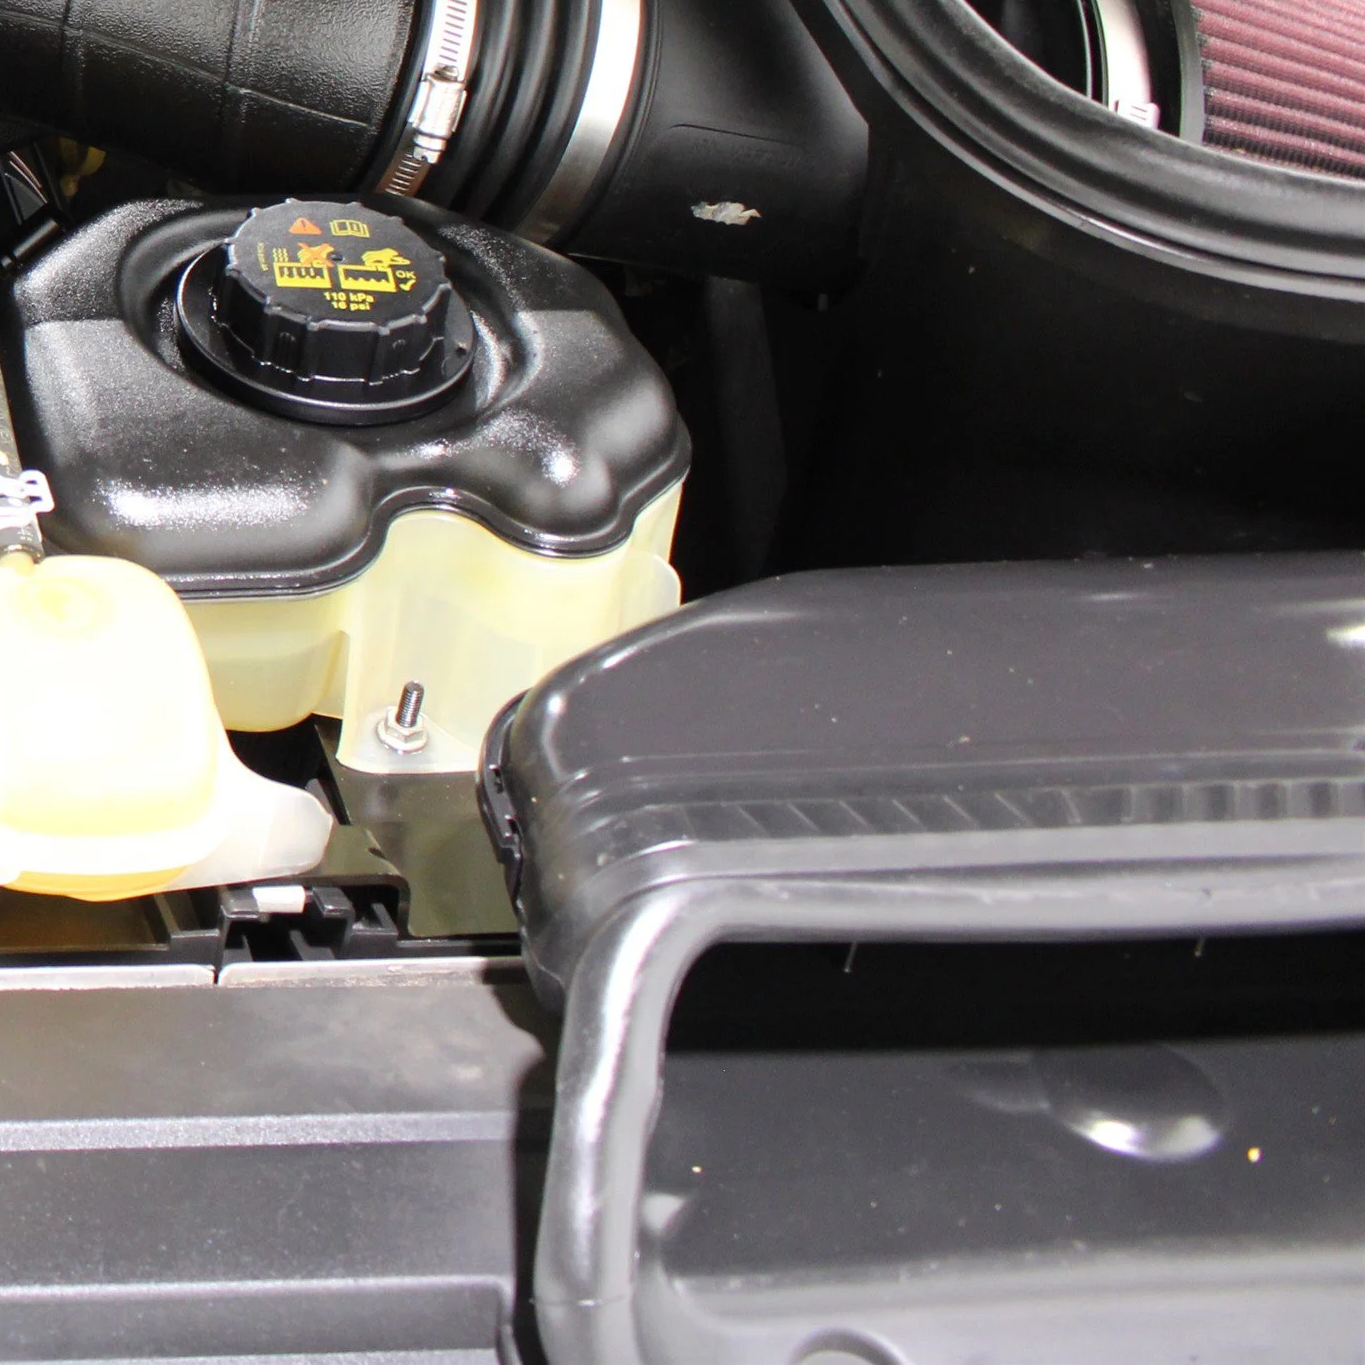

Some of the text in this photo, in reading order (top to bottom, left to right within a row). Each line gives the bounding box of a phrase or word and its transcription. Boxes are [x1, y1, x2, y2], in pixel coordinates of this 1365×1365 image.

[396, 269, 417, 281] OK
[323, 291, 375, 303] 110 kPa
[331, 301, 371, 312] 16 psi
